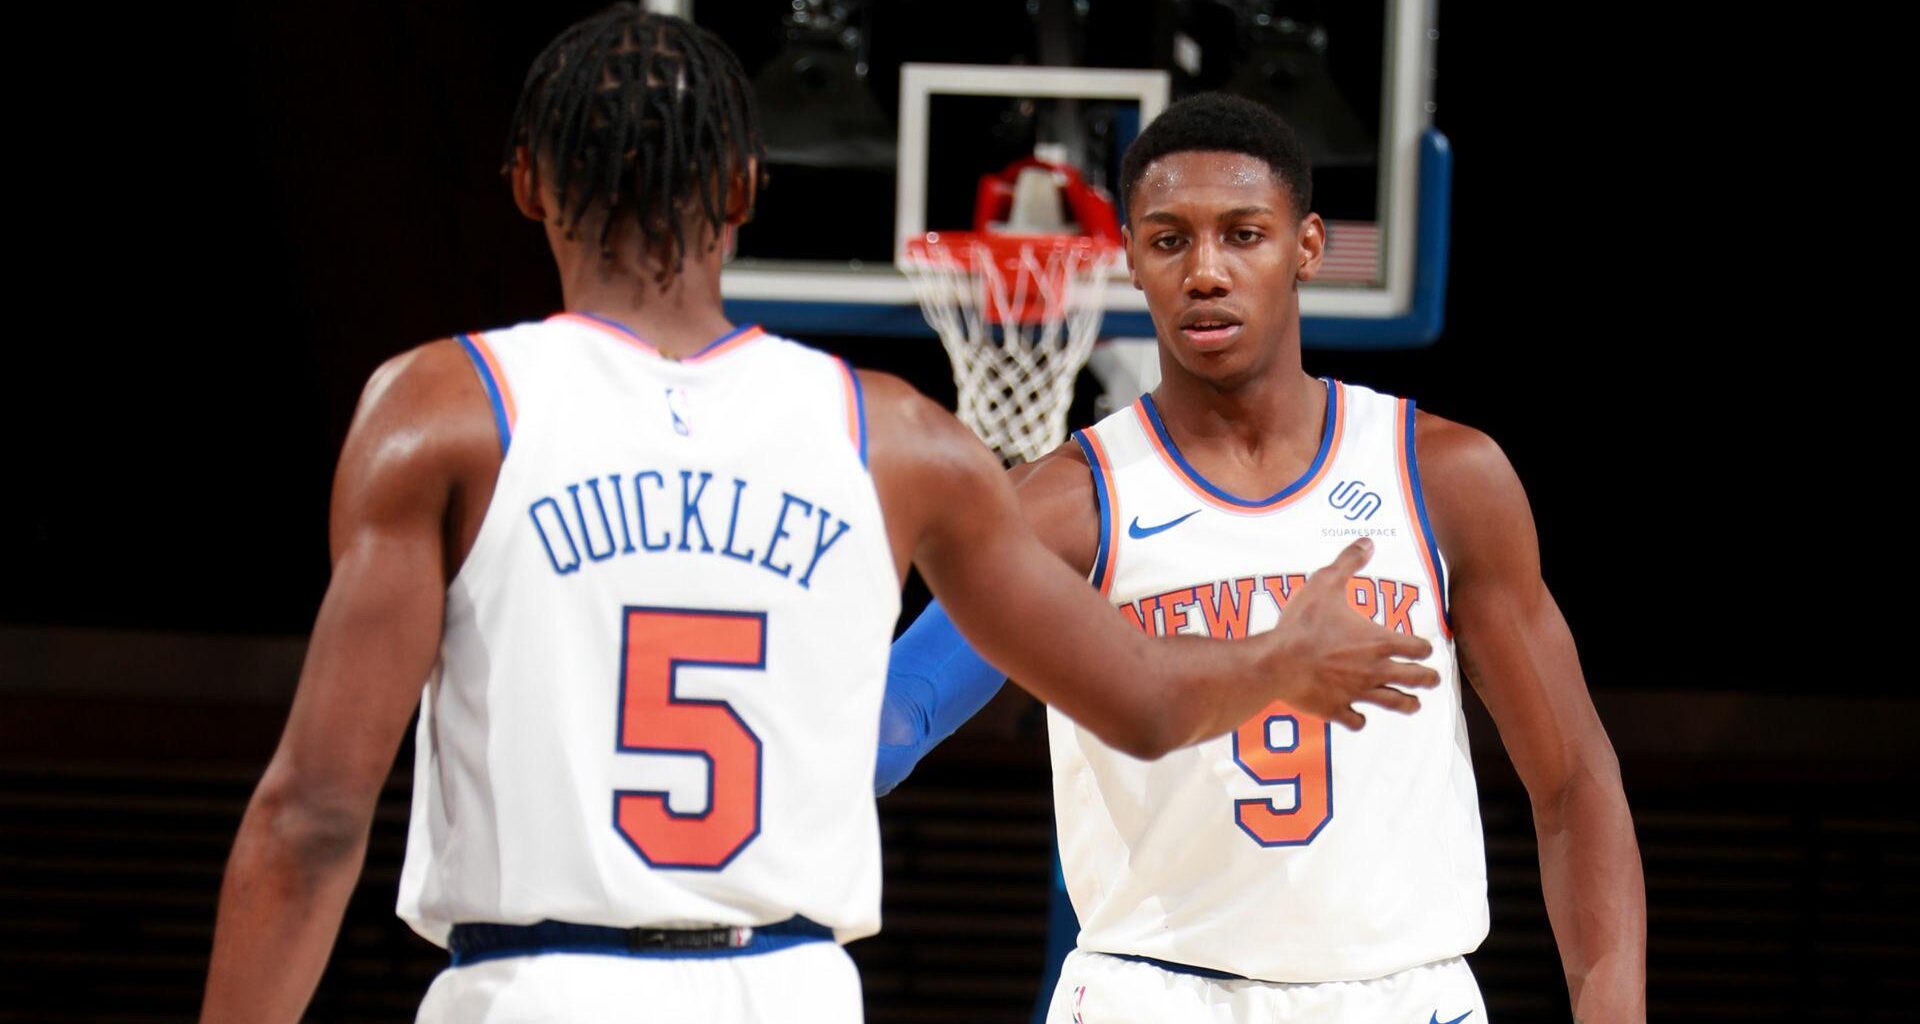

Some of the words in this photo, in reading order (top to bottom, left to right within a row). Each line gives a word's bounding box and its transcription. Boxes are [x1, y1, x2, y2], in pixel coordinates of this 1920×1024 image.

[529, 470, 851, 590] QUICKLEY
[1321, 528, 1397, 537] SQUARESPACE
[1262, 574, 1420, 637] YRK
[612, 604, 768, 872] 5
[1232, 699, 1333, 848] 9
